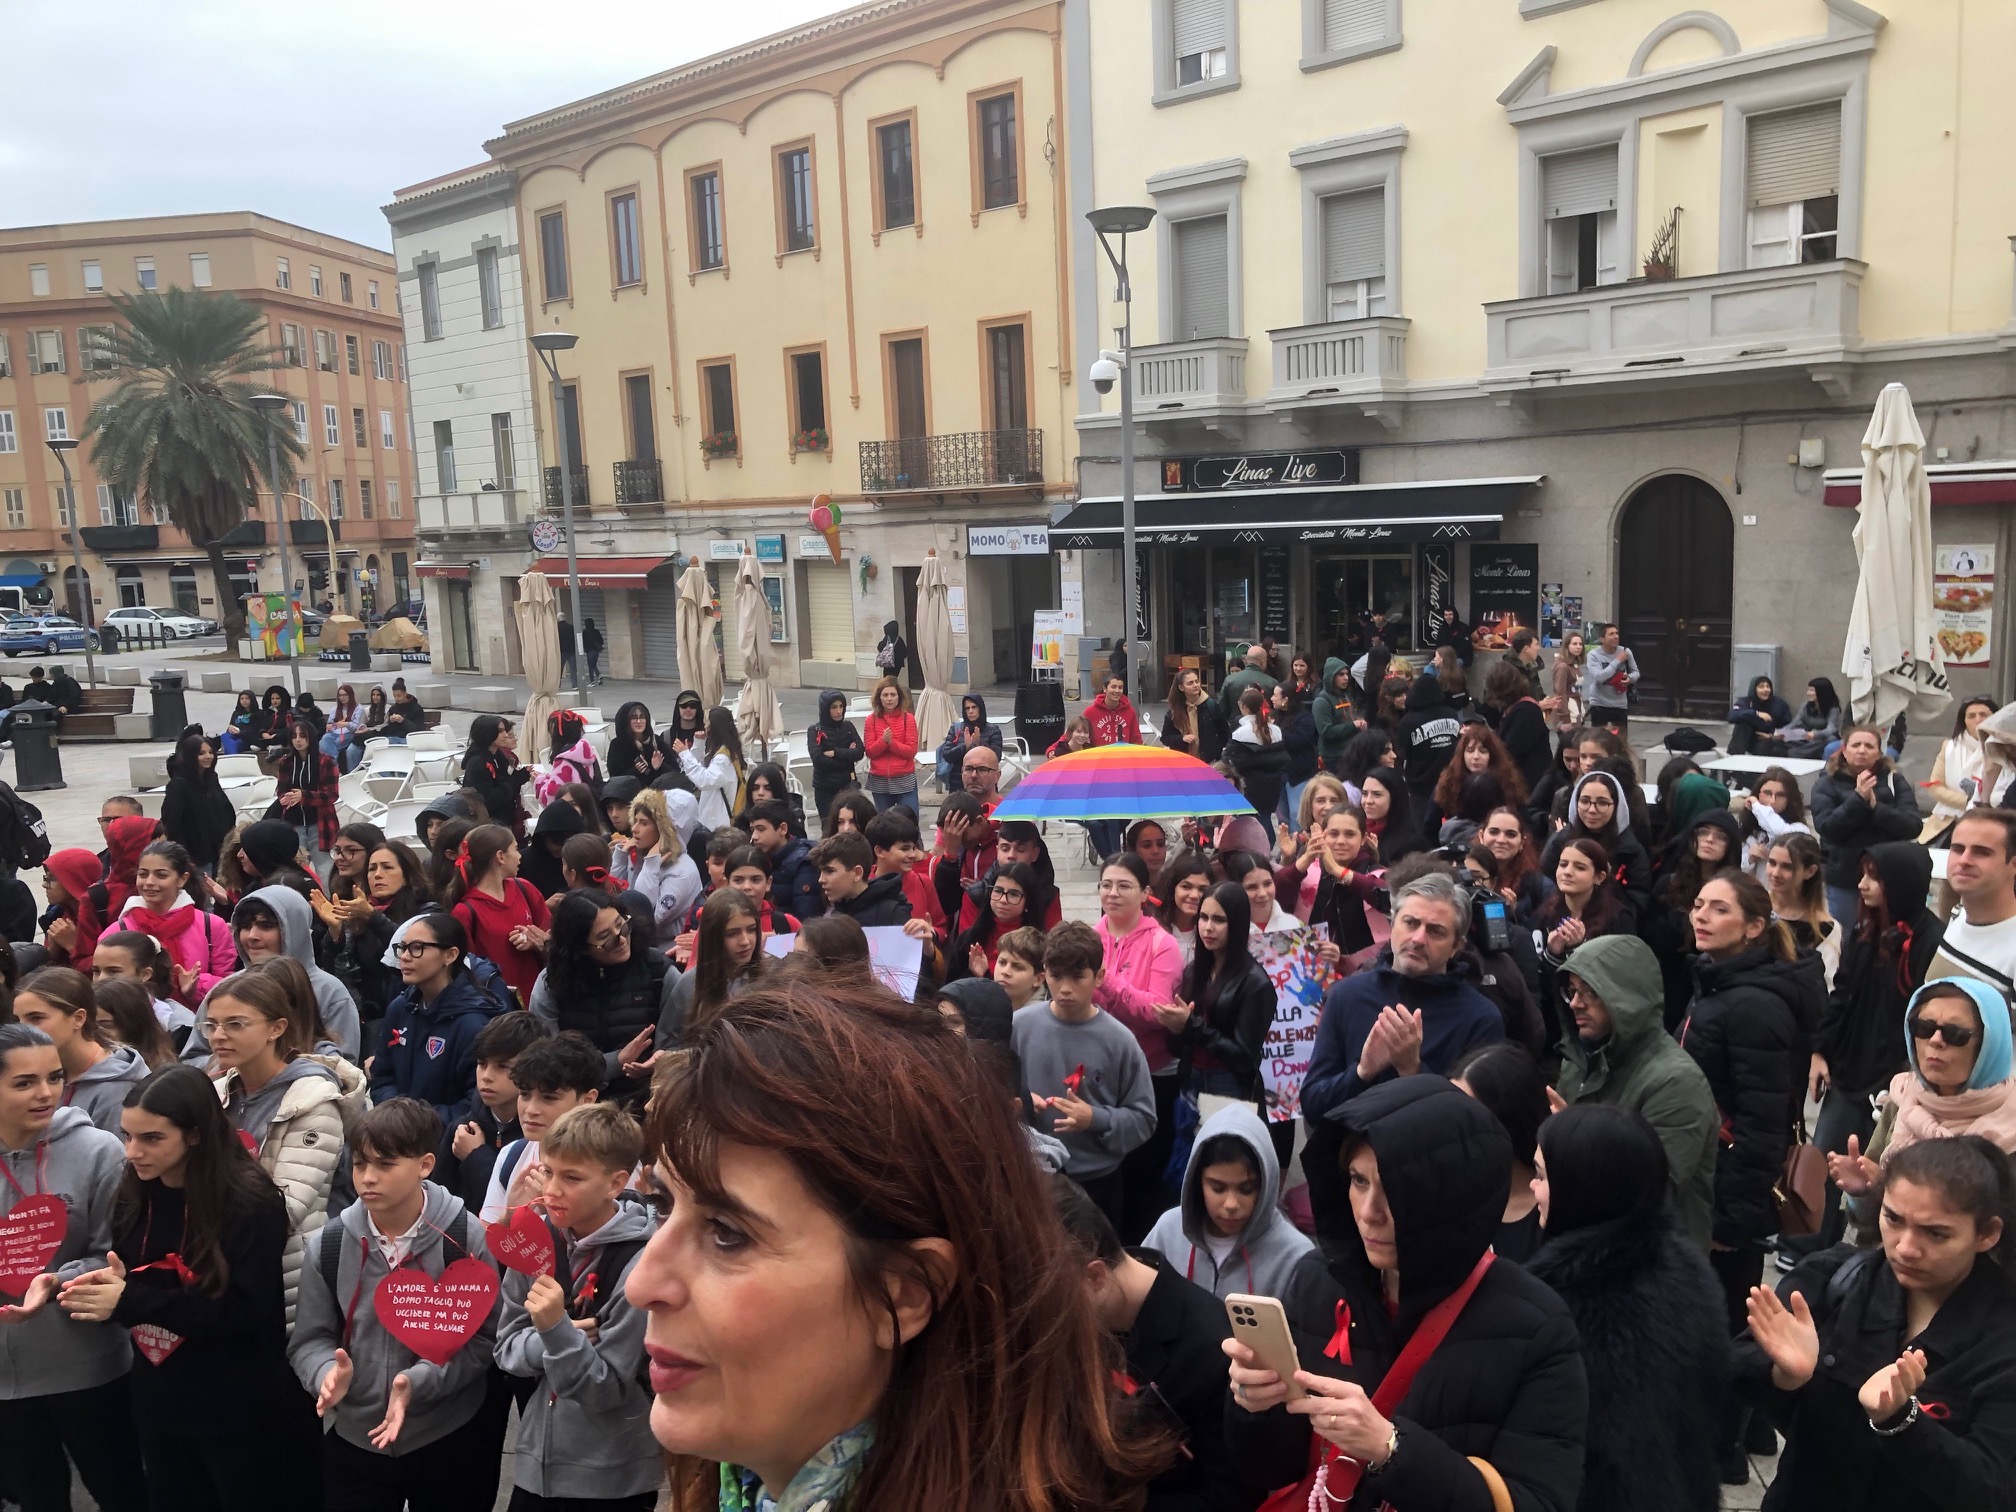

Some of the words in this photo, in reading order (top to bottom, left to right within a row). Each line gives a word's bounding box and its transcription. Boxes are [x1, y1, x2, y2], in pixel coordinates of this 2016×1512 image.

[1221, 458, 1274, 488] Linas
[1281, 455, 1317, 482] Live
[534, 523, 557, 538] PIZZA
[1340, 527, 1366, 539] Monte
[1369, 526, 1392, 539] Linas
[971, 533, 1005, 546] MOMO
[1023, 533, 1047, 545] TEA
[1474, 565, 1503, 577] Monte
[1506, 565, 1531, 577] Linas
[1426, 553, 1449, 609] Linas
[1262, 1044, 1294, 1060] ULLE
[8, 1211, 27, 1221] NON
[28, 1209, 37, 1218] TI
[515, 1231, 527, 1245] LE
[520, 1242, 538, 1259] MANI
[387, 1283, 426, 1294] L'AMORE
[445, 1284, 457, 1293] UN
[459, 1283, 481, 1293] ARMA
[484, 1284, 490, 1293] A
[457, 1299, 472, 1308] PUÒ
[395, 1309, 431, 1318] UCCIDERE
[435, 1311, 447, 1319] MA
[452, 1312, 469, 1320] PUÒ
[402, 1320, 430, 1331] ANCHE
[433, 1322, 465, 1334] SALVARE
